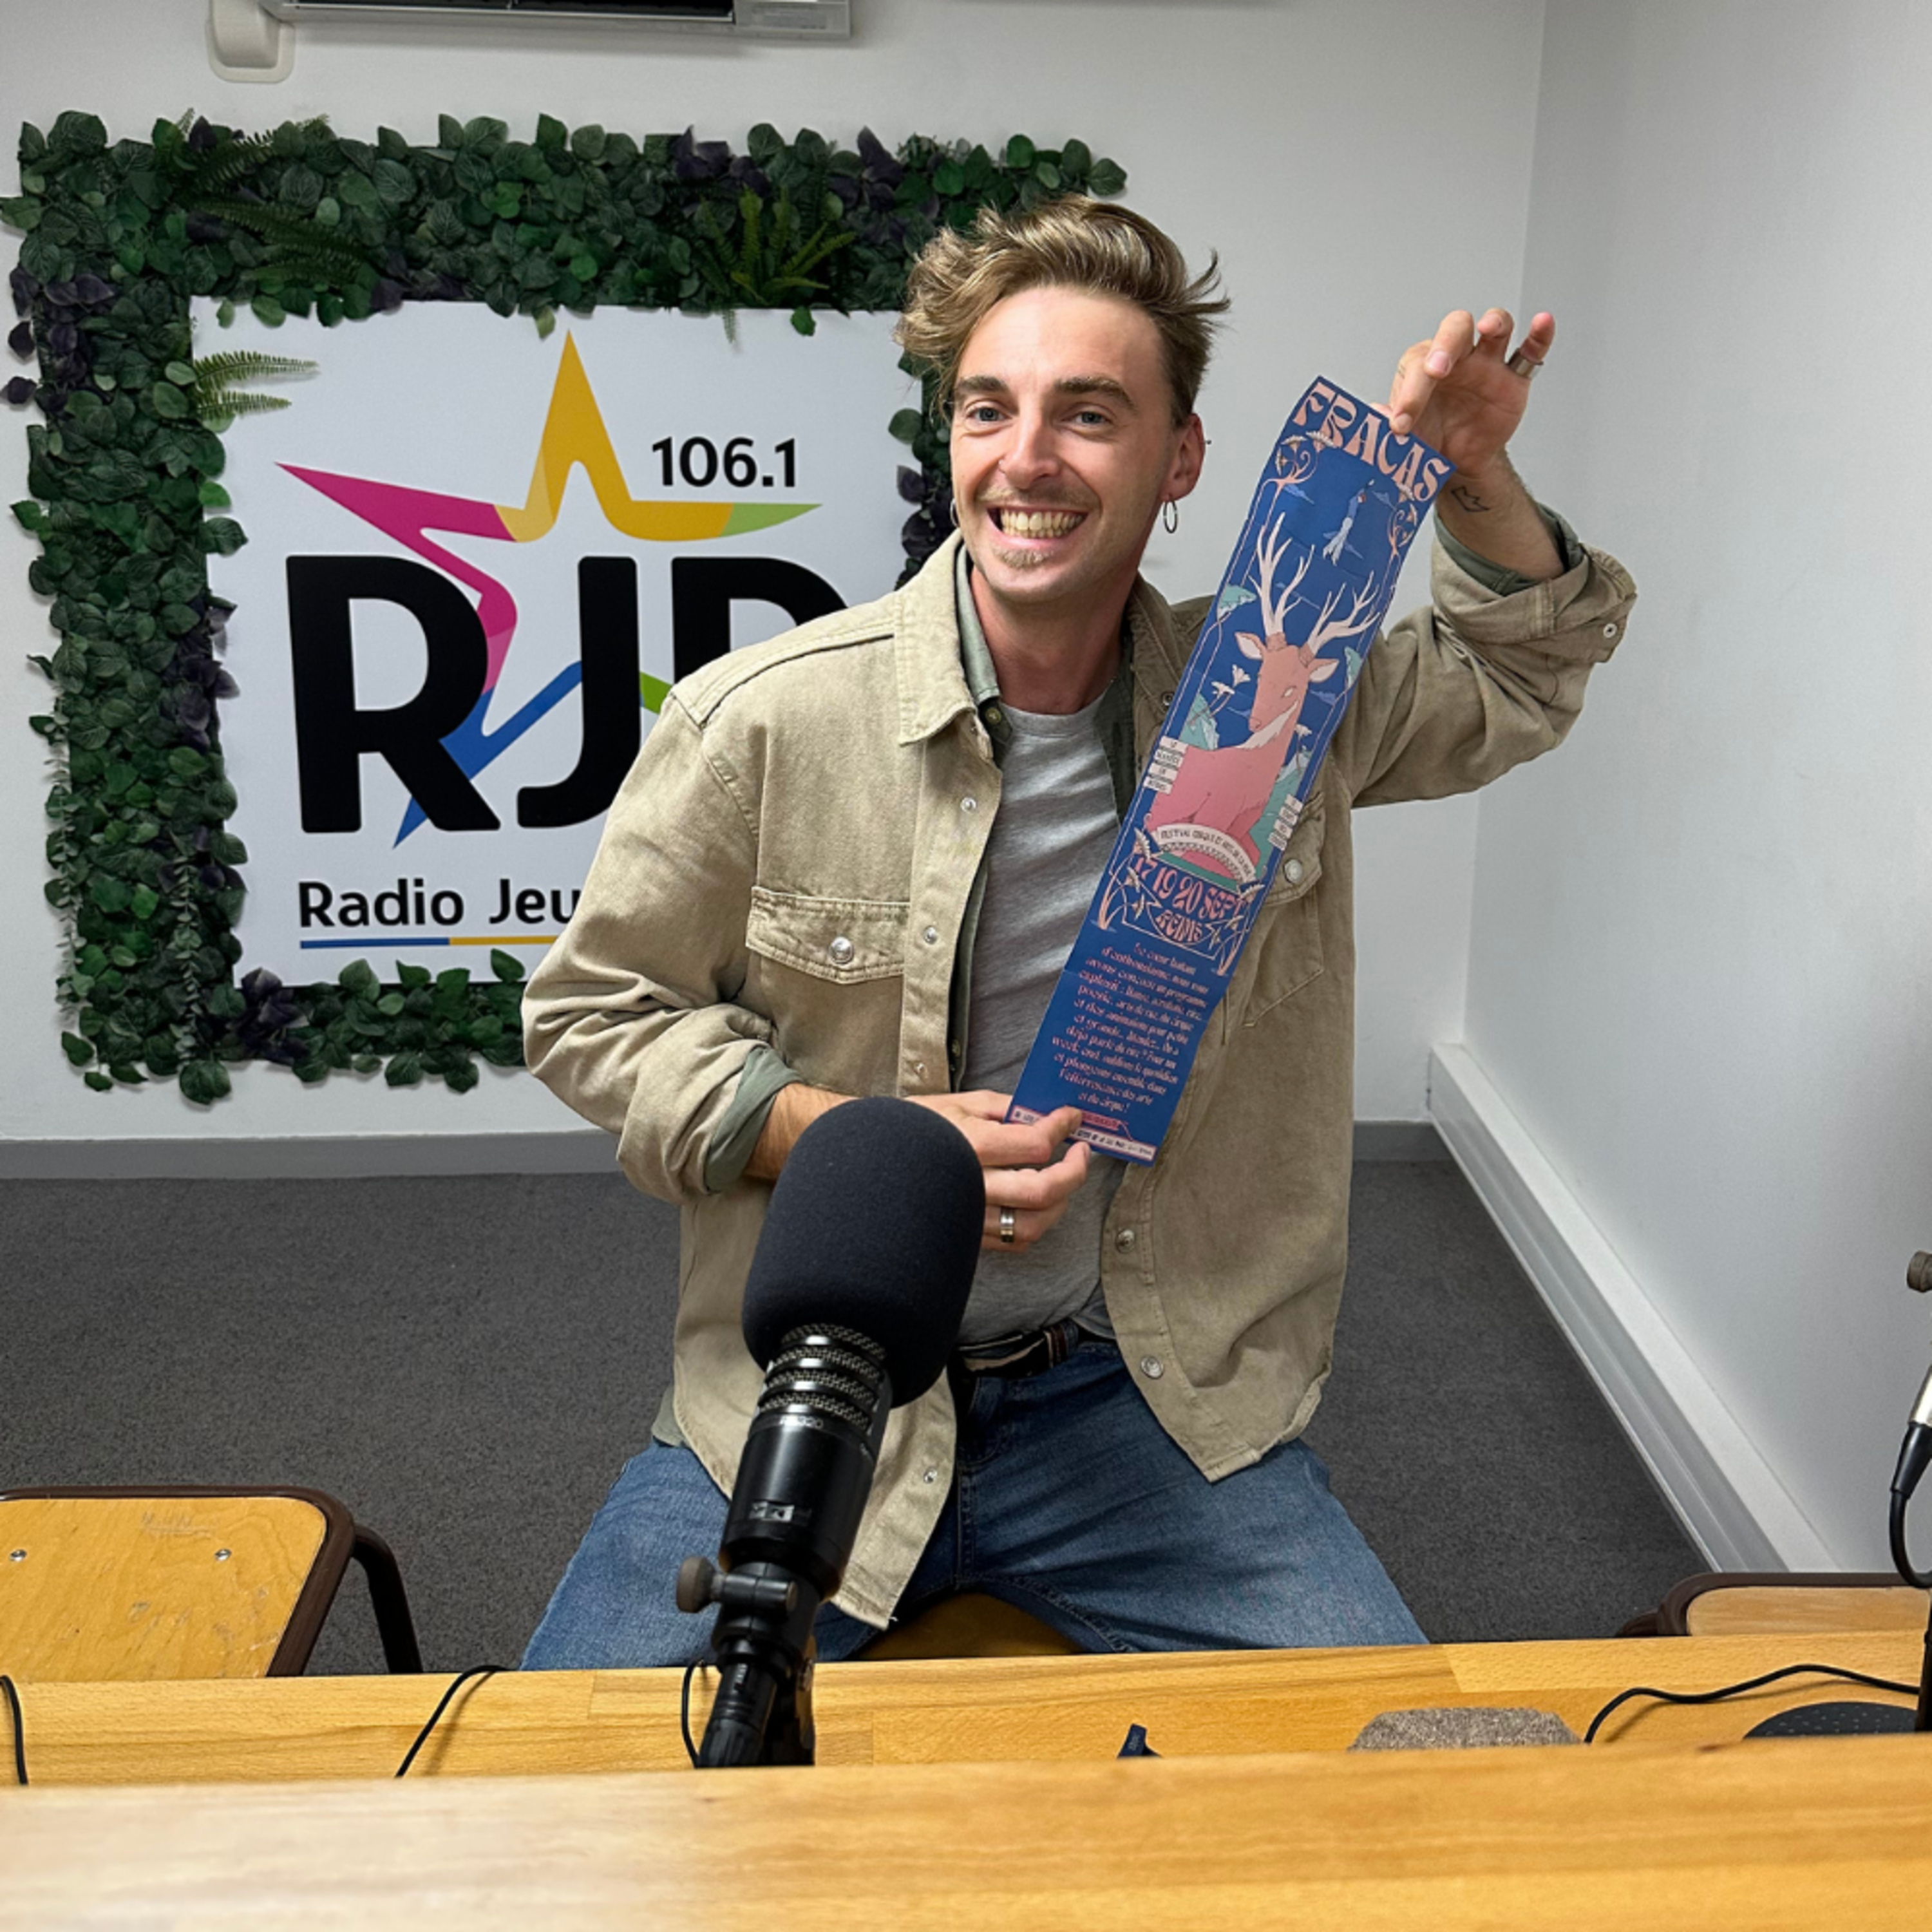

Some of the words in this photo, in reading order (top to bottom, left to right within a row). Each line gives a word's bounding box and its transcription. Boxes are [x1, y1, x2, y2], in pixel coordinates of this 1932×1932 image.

[652, 436, 797, 488] 106.1
[1292, 382, 1450, 502] FRACAS
[298, 878, 464, 928] Radio
[1153, 867, 1177, 899] 19
[1172, 876, 1203, 914] 20
